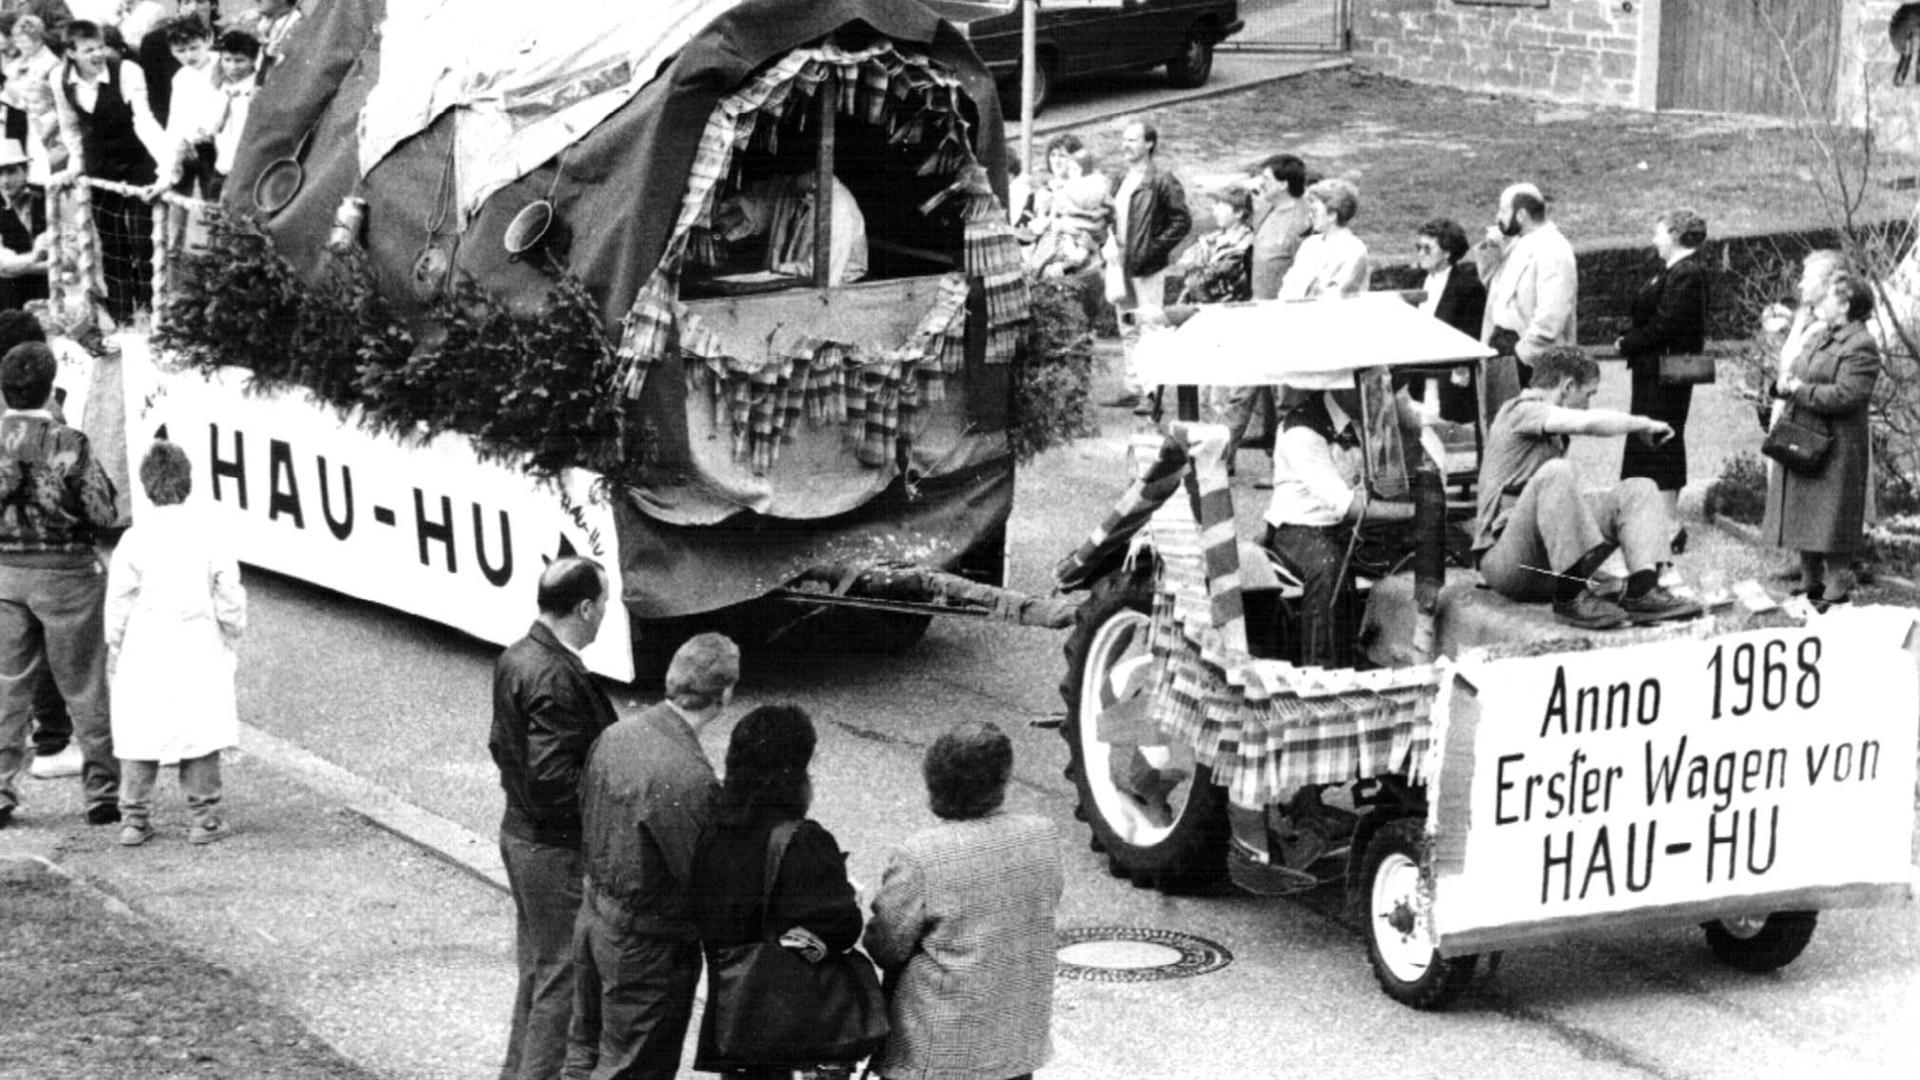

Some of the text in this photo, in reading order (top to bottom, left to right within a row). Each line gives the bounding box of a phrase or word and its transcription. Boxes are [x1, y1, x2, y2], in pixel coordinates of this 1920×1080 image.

[210, 423, 513, 587] HAU-HU
[1540, 636, 1823, 738] Anno 1968
[1495, 735, 1881, 826] Erster Wagen von
[1541, 805, 1780, 905] HAU-HU
